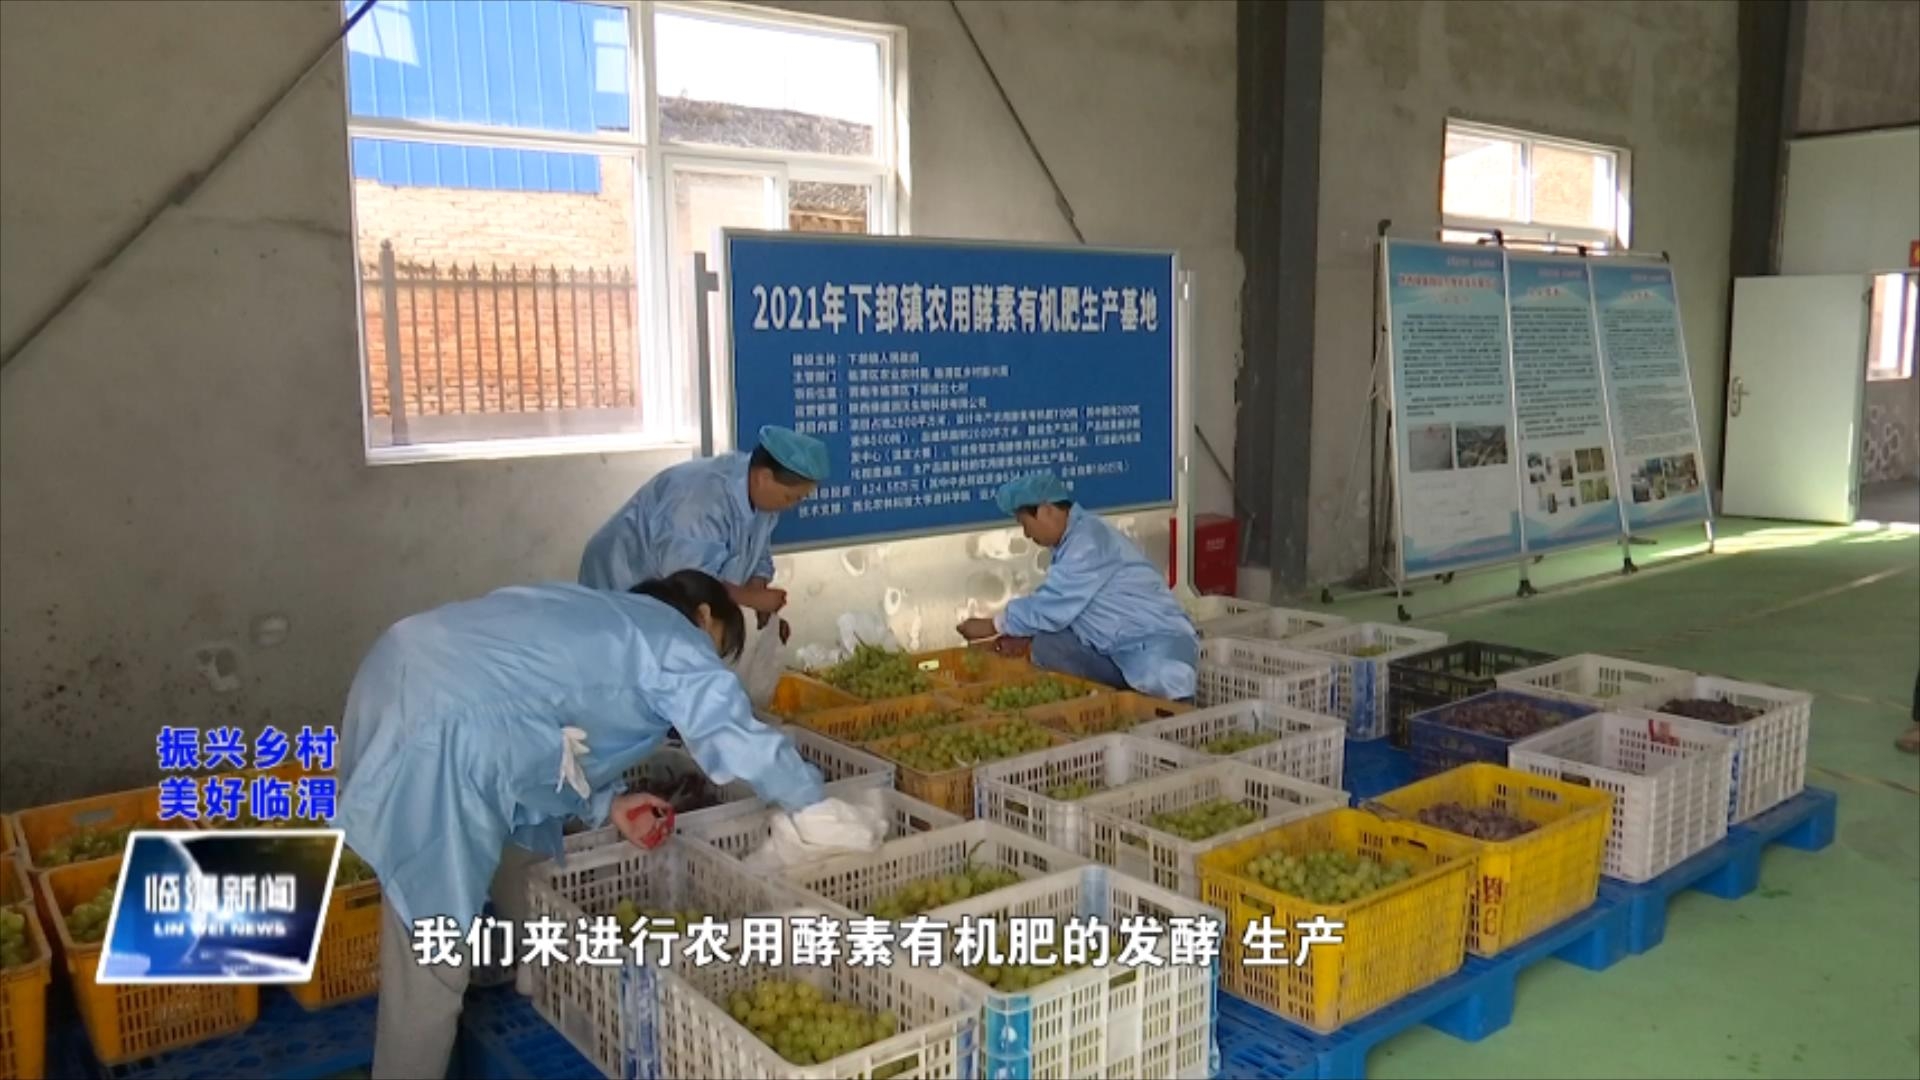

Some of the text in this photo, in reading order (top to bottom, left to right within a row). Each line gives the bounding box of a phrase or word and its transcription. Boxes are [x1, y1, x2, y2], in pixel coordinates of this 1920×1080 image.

[752, 282, 1158, 336] 2021年下邽镇农用酵素有机肥生产基地
